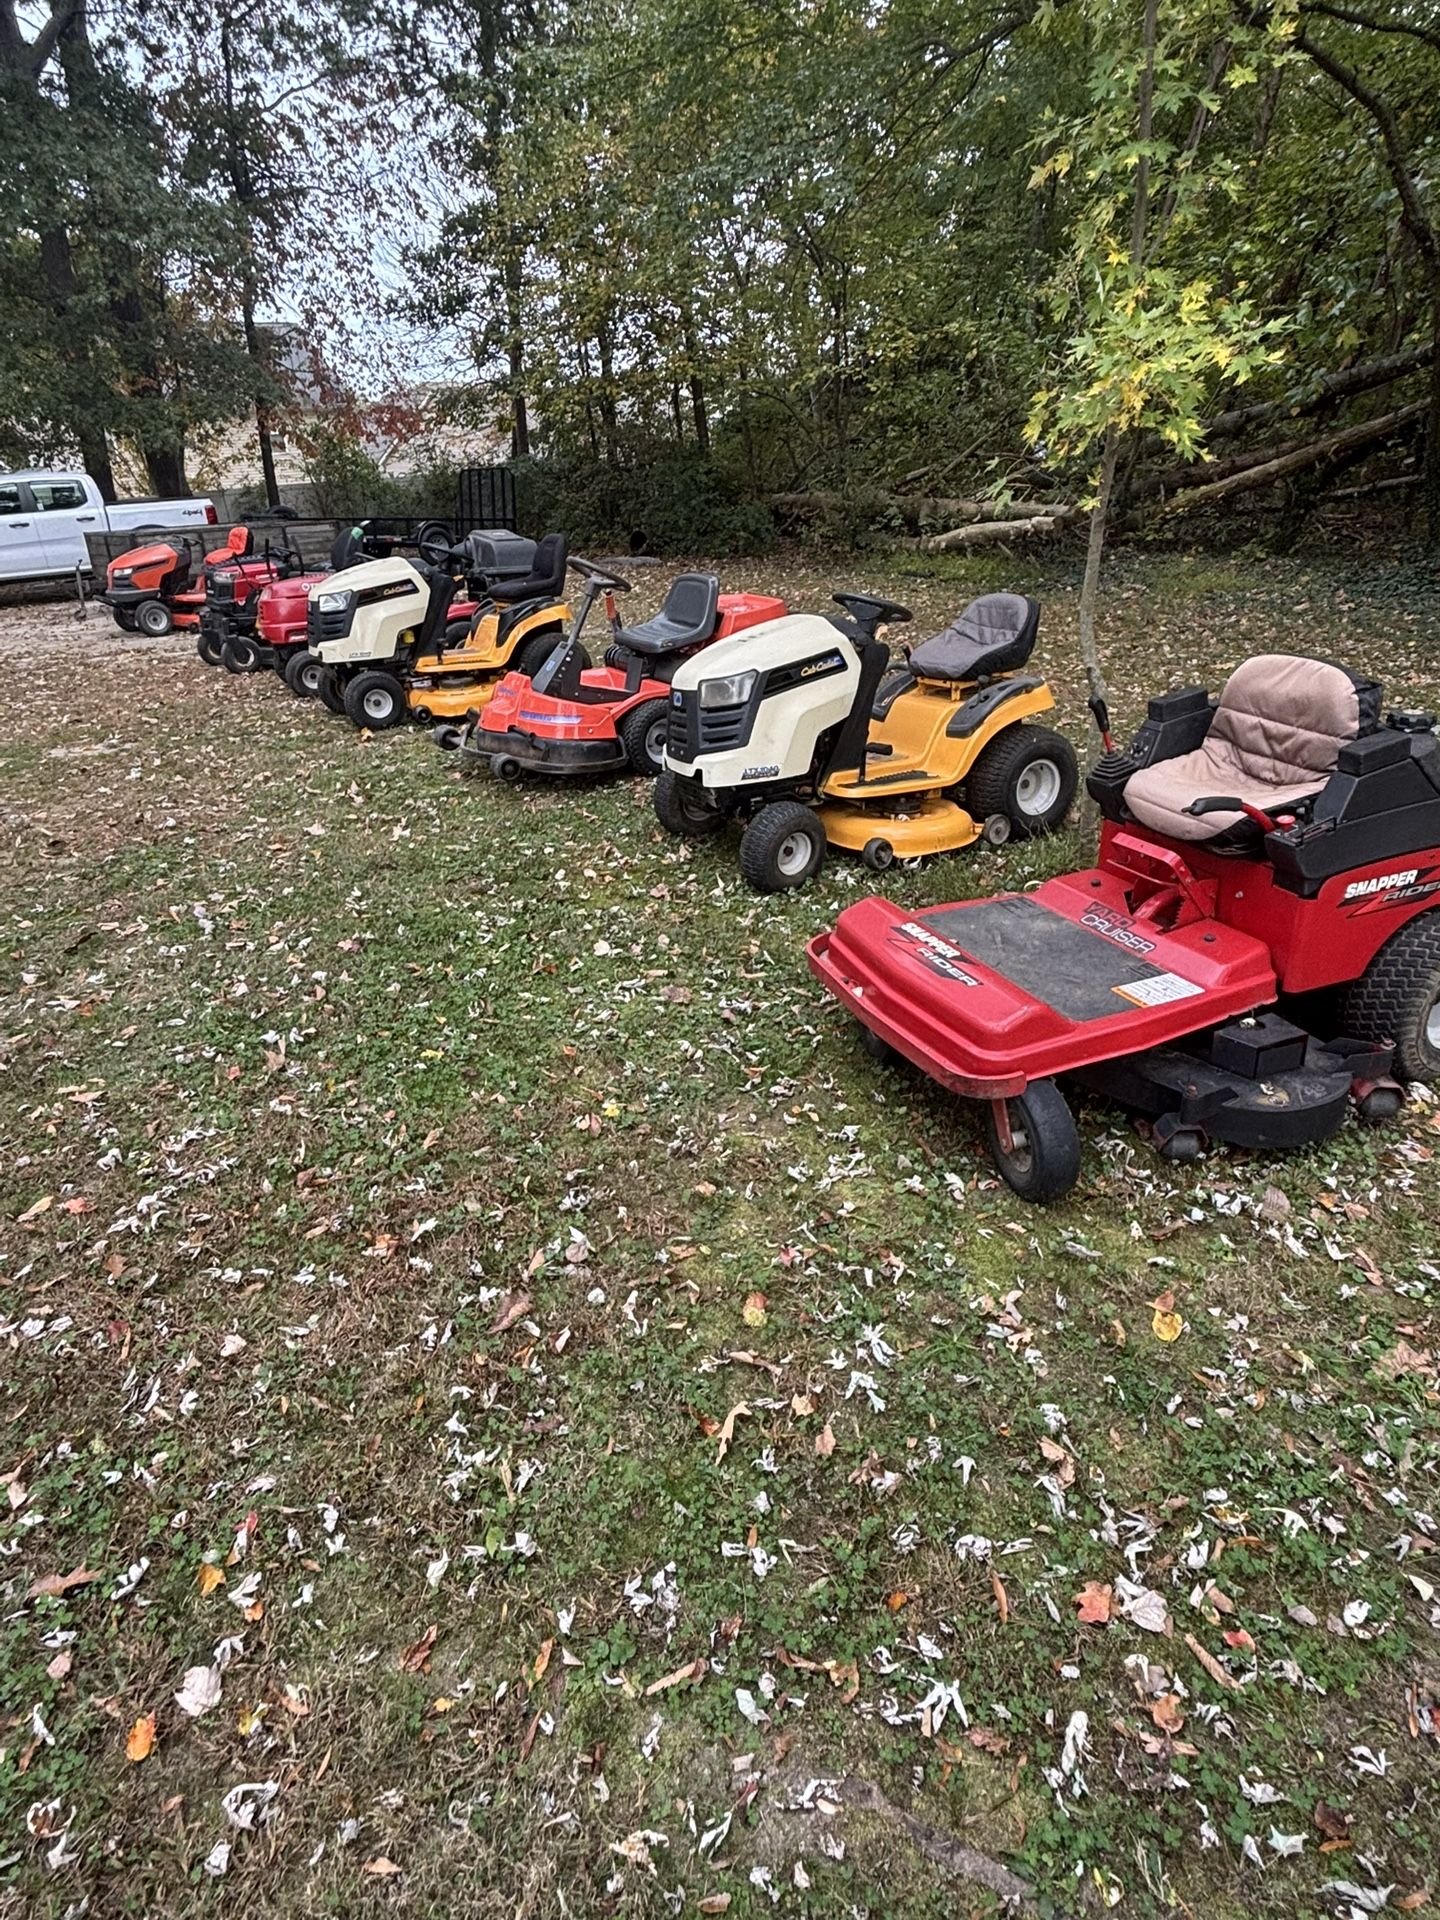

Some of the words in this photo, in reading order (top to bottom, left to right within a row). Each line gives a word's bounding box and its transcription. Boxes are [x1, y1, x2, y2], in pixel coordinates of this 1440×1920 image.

[1344, 869, 1419, 899] SNAPPER
[1382, 880, 1440, 902] RIDE
[1084, 901, 1136, 928] YARD
[901, 922, 961, 958] SNAPPER
[1080, 913, 1157, 954] CRUISER
[915, 947, 979, 987] RIDER
